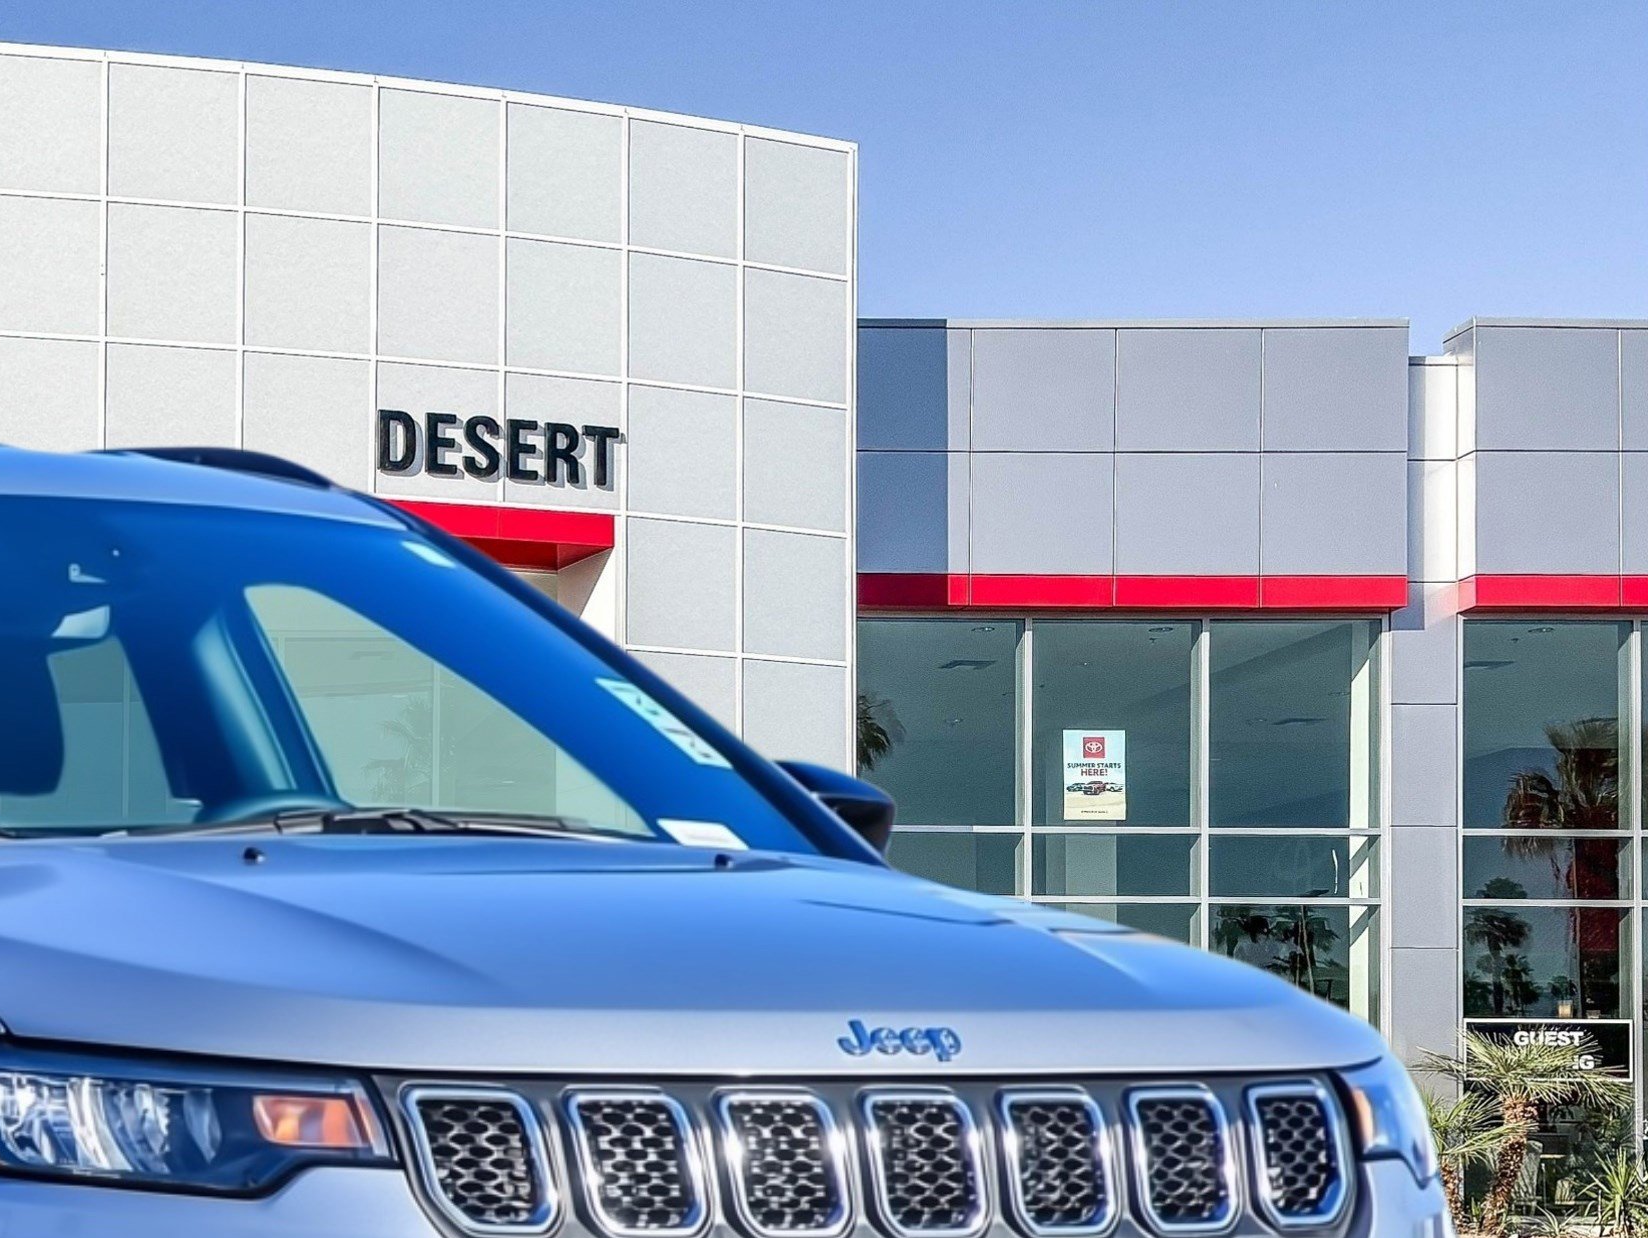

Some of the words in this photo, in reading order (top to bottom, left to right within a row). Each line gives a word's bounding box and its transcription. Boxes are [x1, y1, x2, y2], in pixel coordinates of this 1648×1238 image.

[378, 409, 620, 487] DESERT
[1080, 768, 1108, 776] HERE!
[837, 1019, 962, 1063] Jeep
[1513, 1030, 1584, 1047] GUEST
